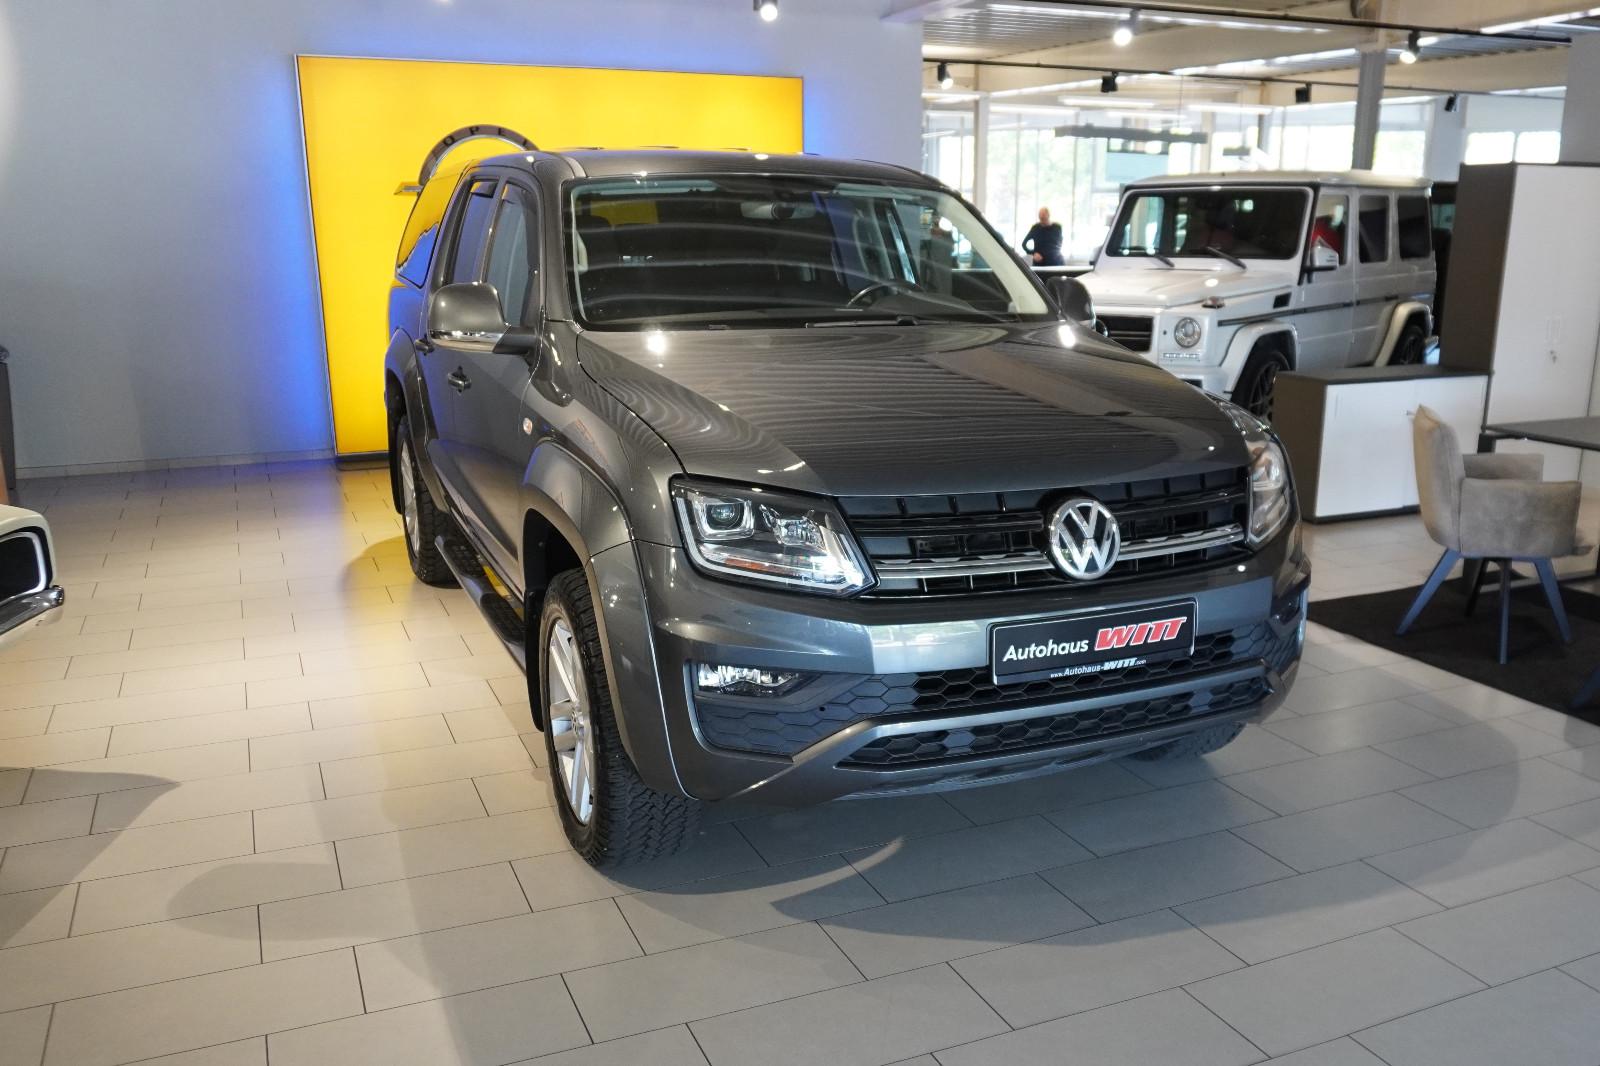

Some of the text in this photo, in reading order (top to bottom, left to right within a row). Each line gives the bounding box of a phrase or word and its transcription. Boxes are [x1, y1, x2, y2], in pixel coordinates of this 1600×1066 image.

[1050, 499, 1121, 580] VW
[1002, 616, 1187, 662] Autohaus WITT
